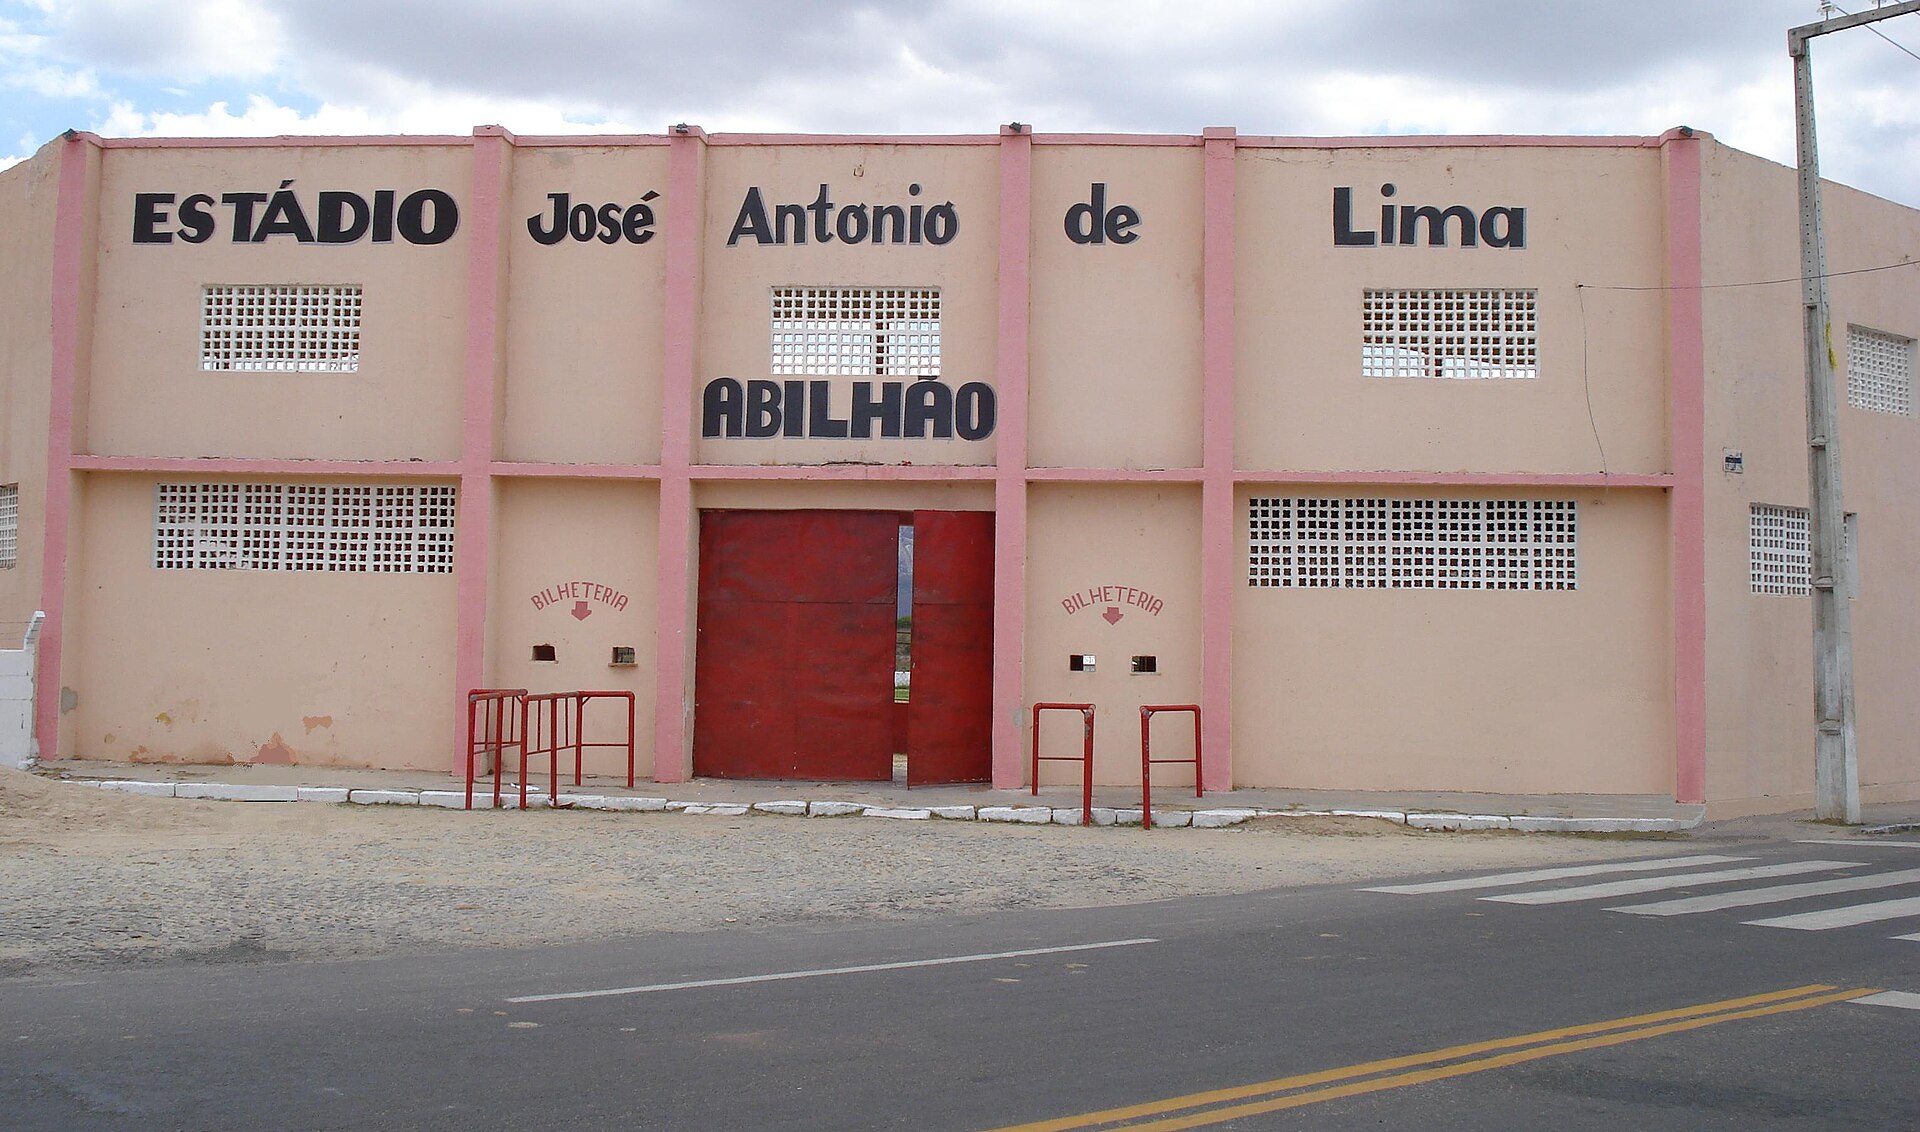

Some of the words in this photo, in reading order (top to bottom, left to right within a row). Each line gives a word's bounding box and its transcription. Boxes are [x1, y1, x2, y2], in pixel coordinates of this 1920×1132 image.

[132, 179, 459, 246] ESTÁDIO
[527, 190, 661, 247] José
[726, 183, 959, 247] Antonio
[1063, 182, 1141, 246] de
[1333, 183, 1526, 249] Lima
[701, 375, 997, 441] ABILHÃO
[530, 581, 629, 612] BILHETERIA
[1061, 585, 1164, 617] BILHETERIA
